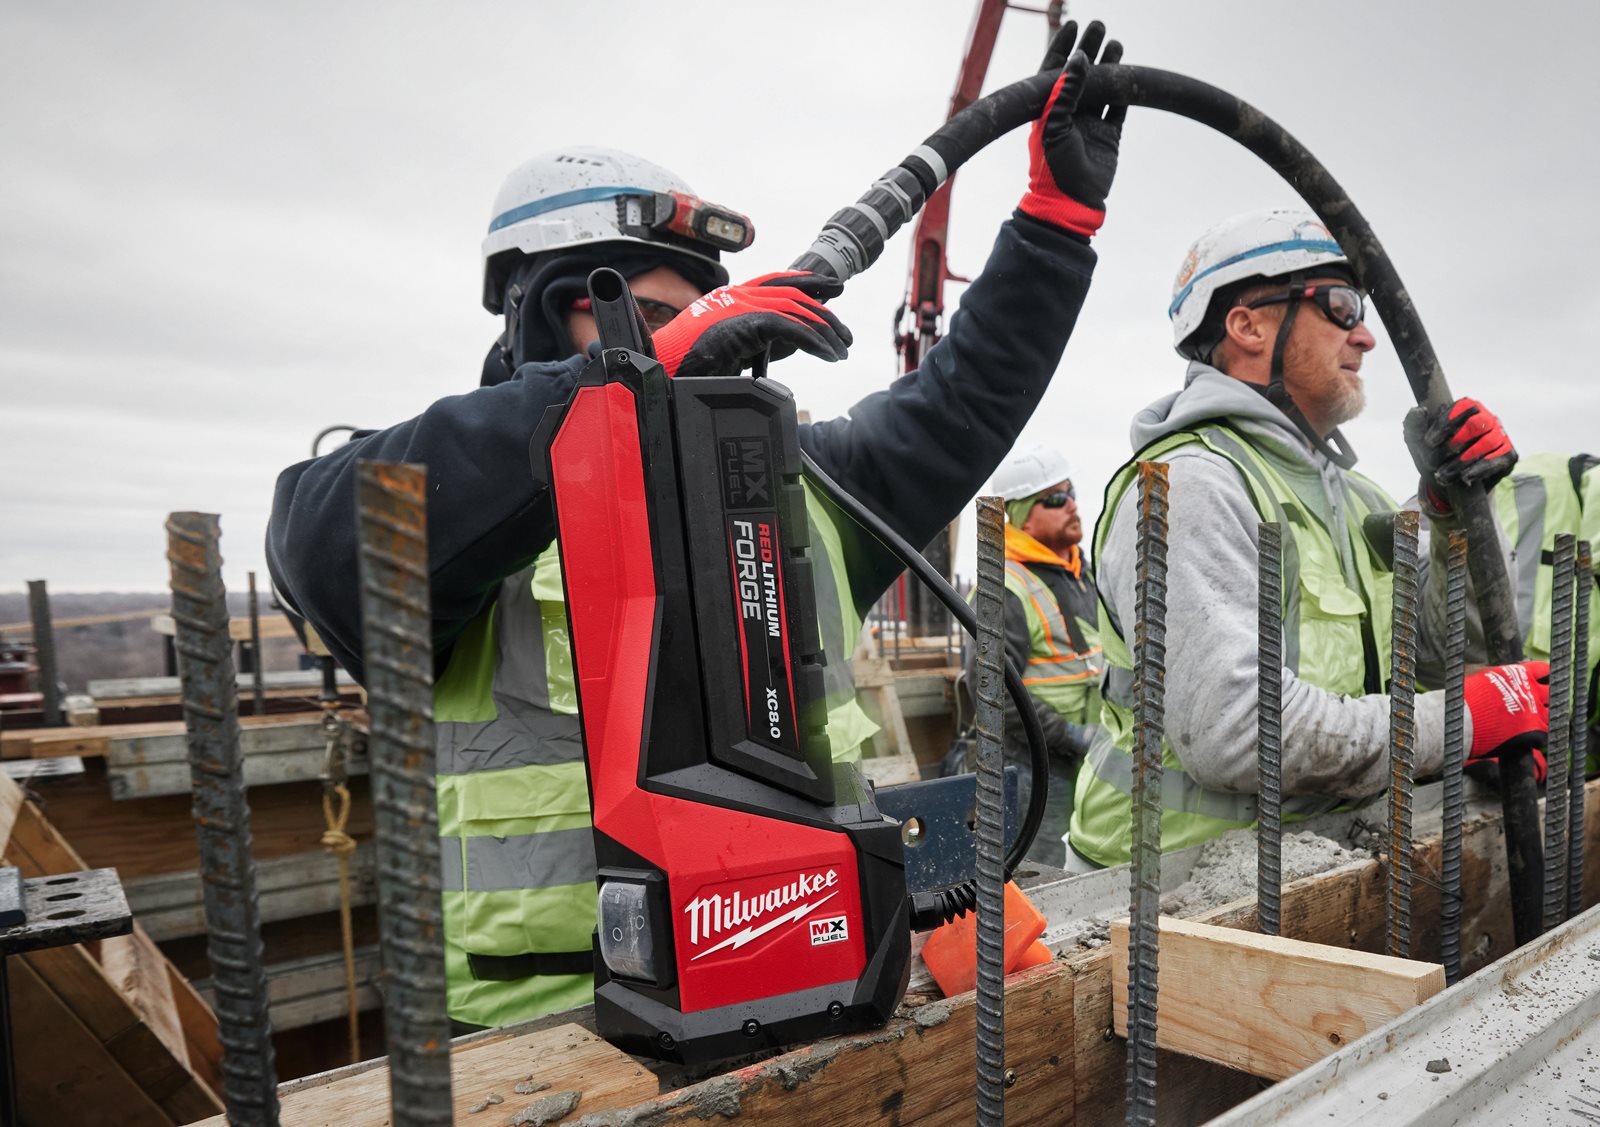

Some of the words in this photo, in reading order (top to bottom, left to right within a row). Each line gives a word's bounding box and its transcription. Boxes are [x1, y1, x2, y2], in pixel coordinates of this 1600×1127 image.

[726, 442, 742, 505] FUEL
[742, 441, 769, 502] MX
[734, 520, 762, 620] FORGE
[758, 523, 780, 637] REDLITHIUM
[766, 687, 781, 739] XC8.0
[684, 868, 839, 945] Milwaukee
[812, 919, 845, 935] MX
[813, 933, 847, 943] FUEL
